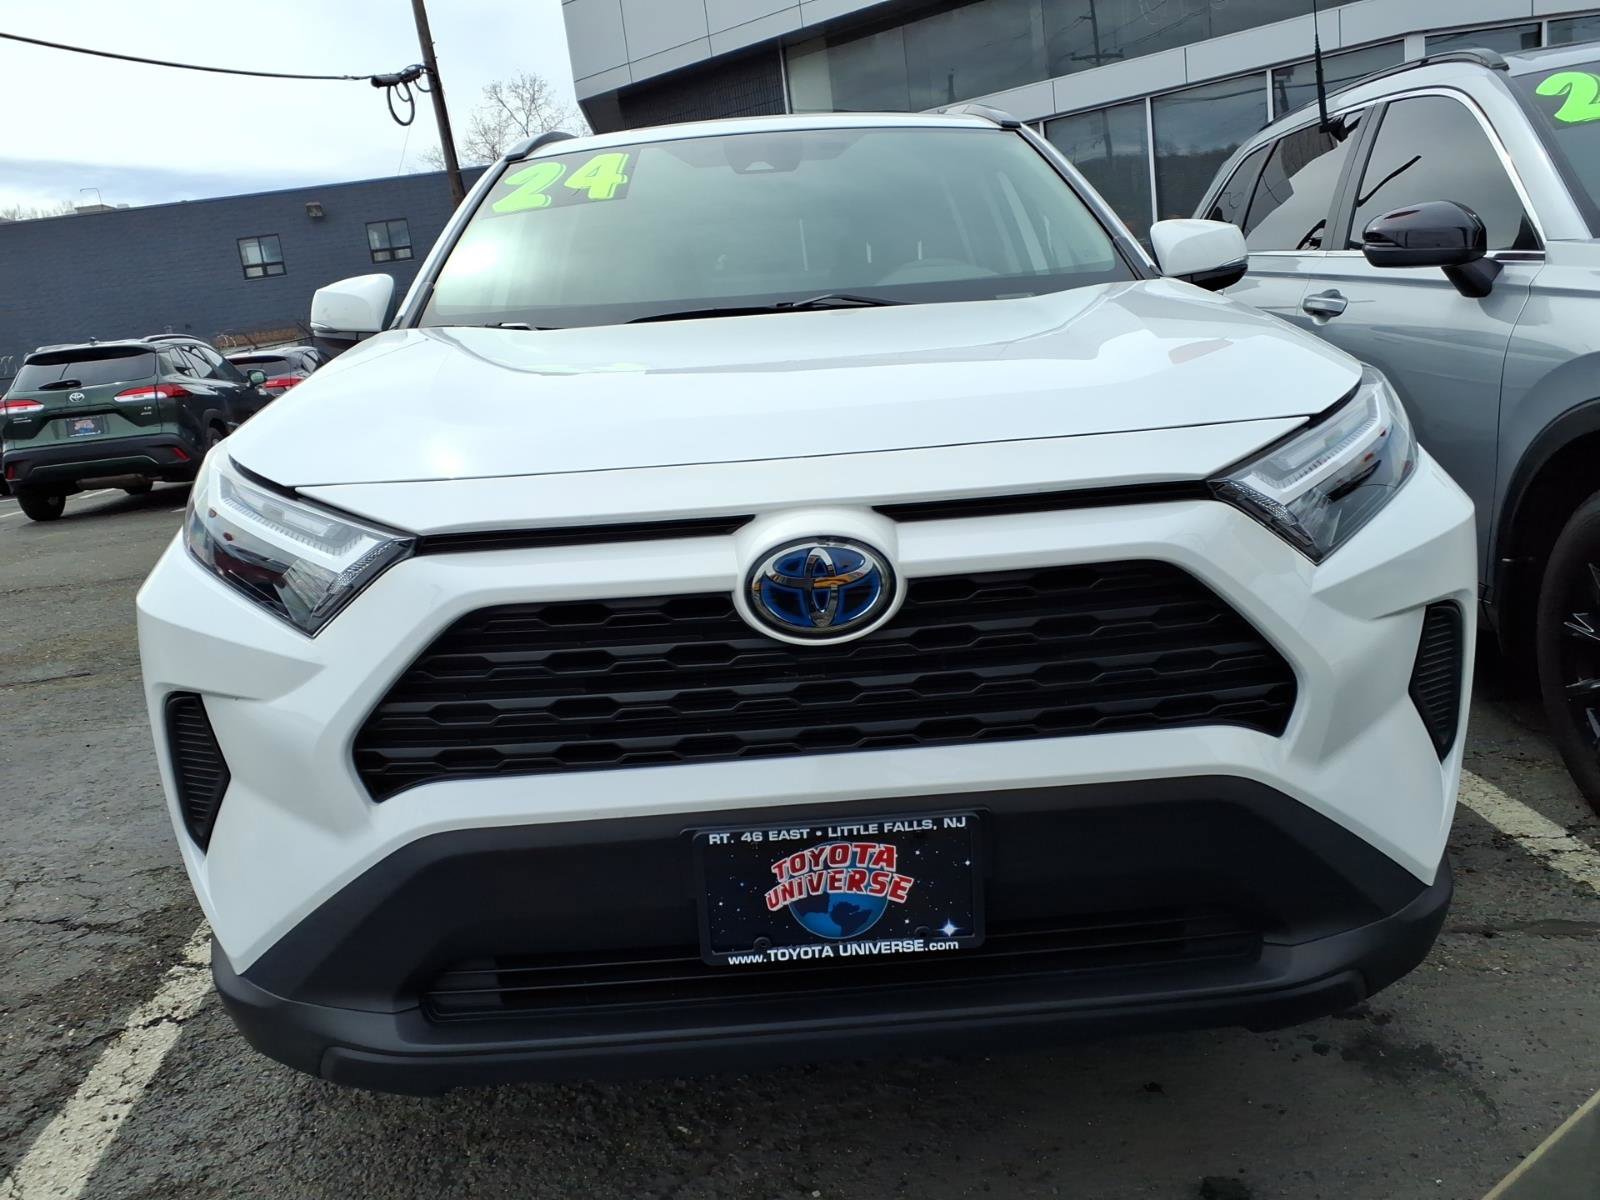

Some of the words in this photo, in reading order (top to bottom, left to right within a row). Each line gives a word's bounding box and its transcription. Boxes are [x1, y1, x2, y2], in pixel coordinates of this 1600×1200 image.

[492, 153, 629, 213] 24
[708, 833, 734, 845] RT.
[741, 832, 763, 842] 46
[768, 828, 810, 842] EAST
[827, 824, 878, 838] LITTLE
[883, 819, 937, 834] FALLS,
[943, 816, 967, 829] NJ
[771, 842, 897, 882] TOYOTA
[765, 867, 914, 912] UNIVERSE
[839, 939, 959, 957] UNIVERSE.com
